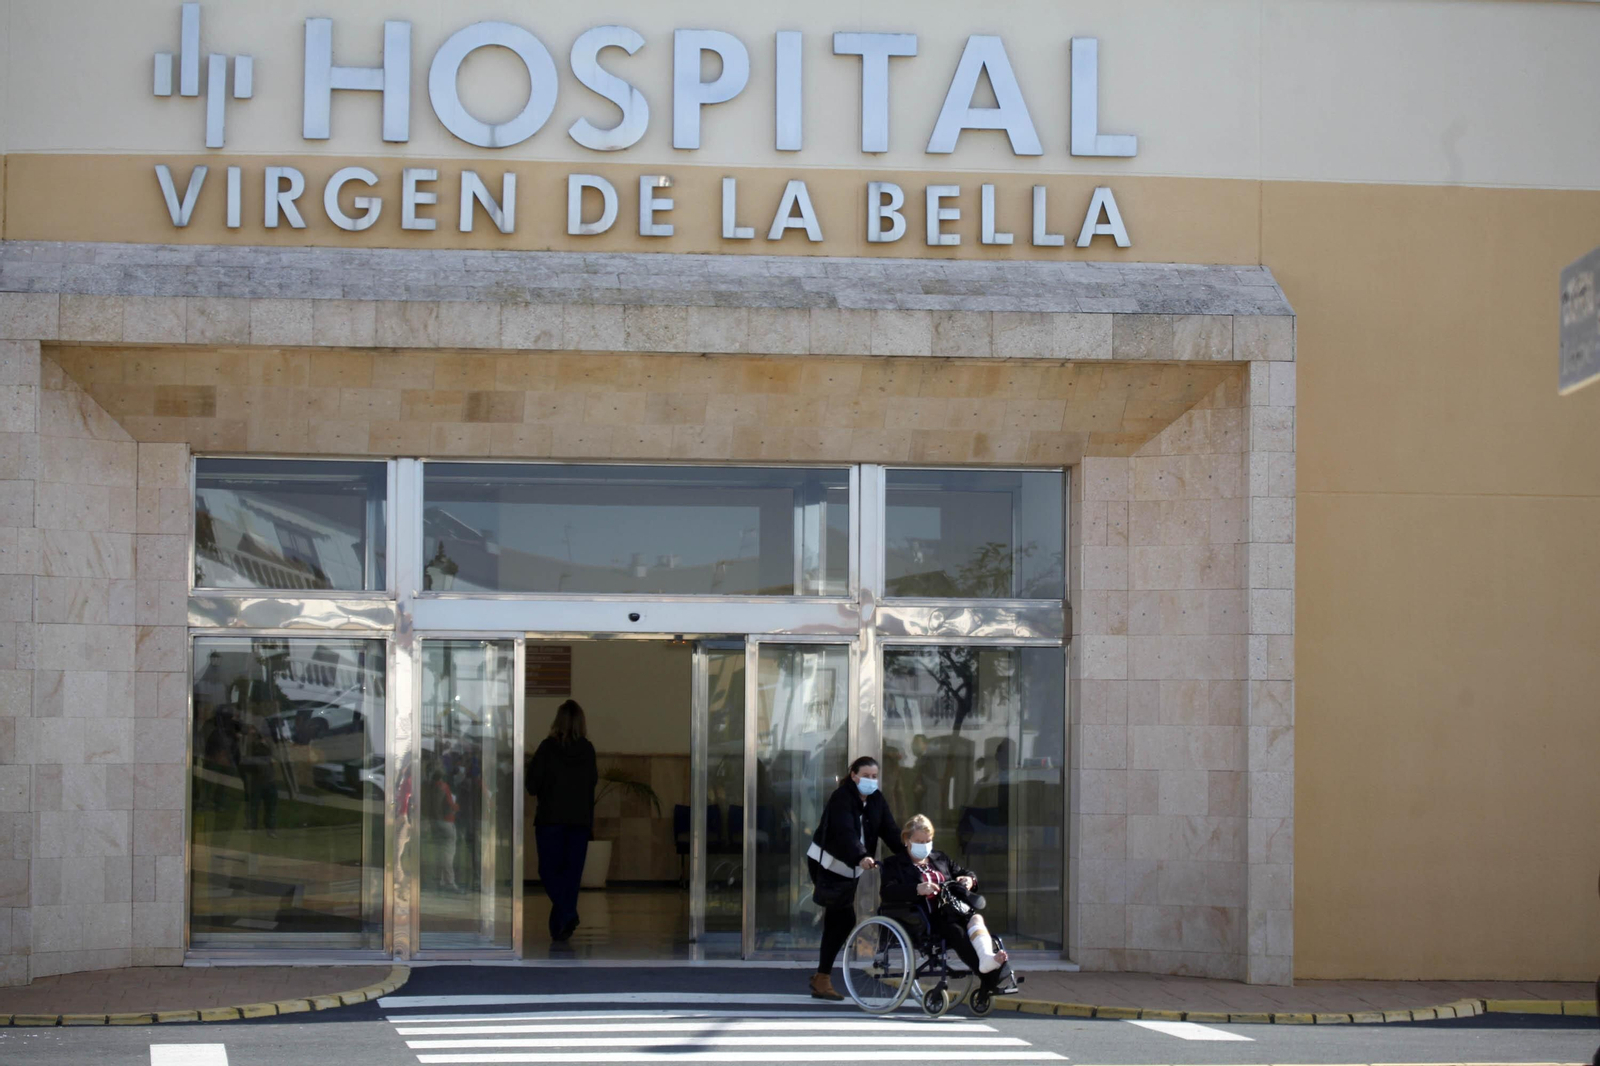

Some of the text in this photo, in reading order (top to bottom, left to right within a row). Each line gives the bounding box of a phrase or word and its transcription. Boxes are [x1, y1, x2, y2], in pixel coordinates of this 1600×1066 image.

[302, 18, 1137, 157] HOSPITAL
[155, 165, 1131, 247] VIRGEN DE LA BELLA
